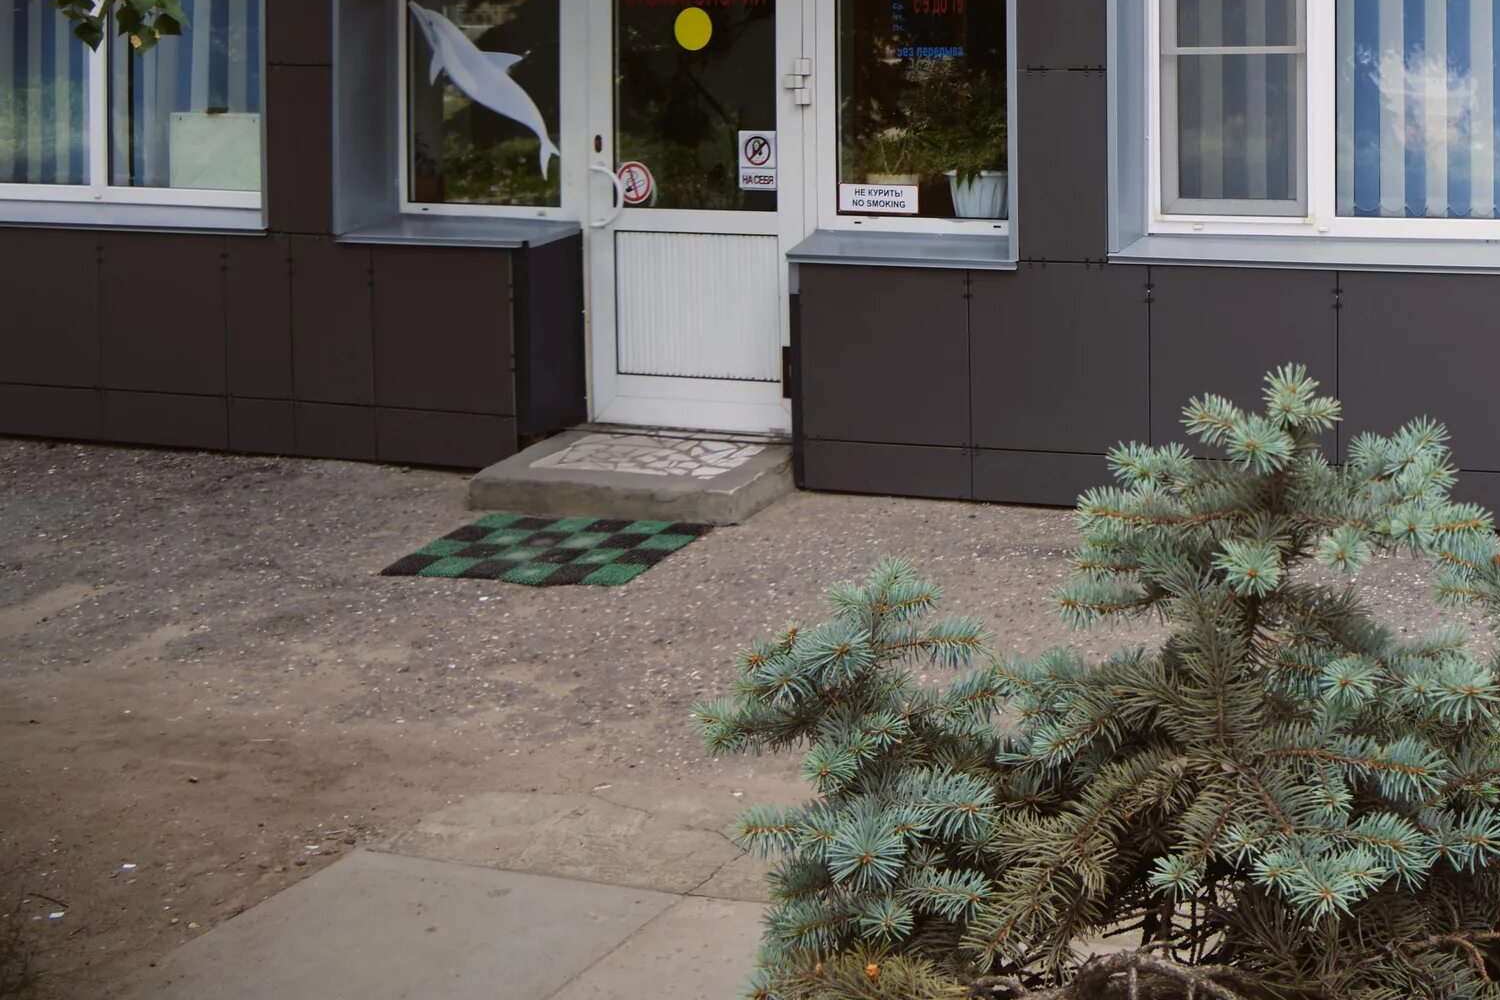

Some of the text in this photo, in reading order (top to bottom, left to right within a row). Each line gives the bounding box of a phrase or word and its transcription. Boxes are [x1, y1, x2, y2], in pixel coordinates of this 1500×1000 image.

[916, 46, 964, 60] перерыва
[743, 175, 774, 185] НА СЕБЯ
[854, 188, 903, 197] НЕ КУРИТЬ!
[852, 199, 906, 208] NO SMOKING
